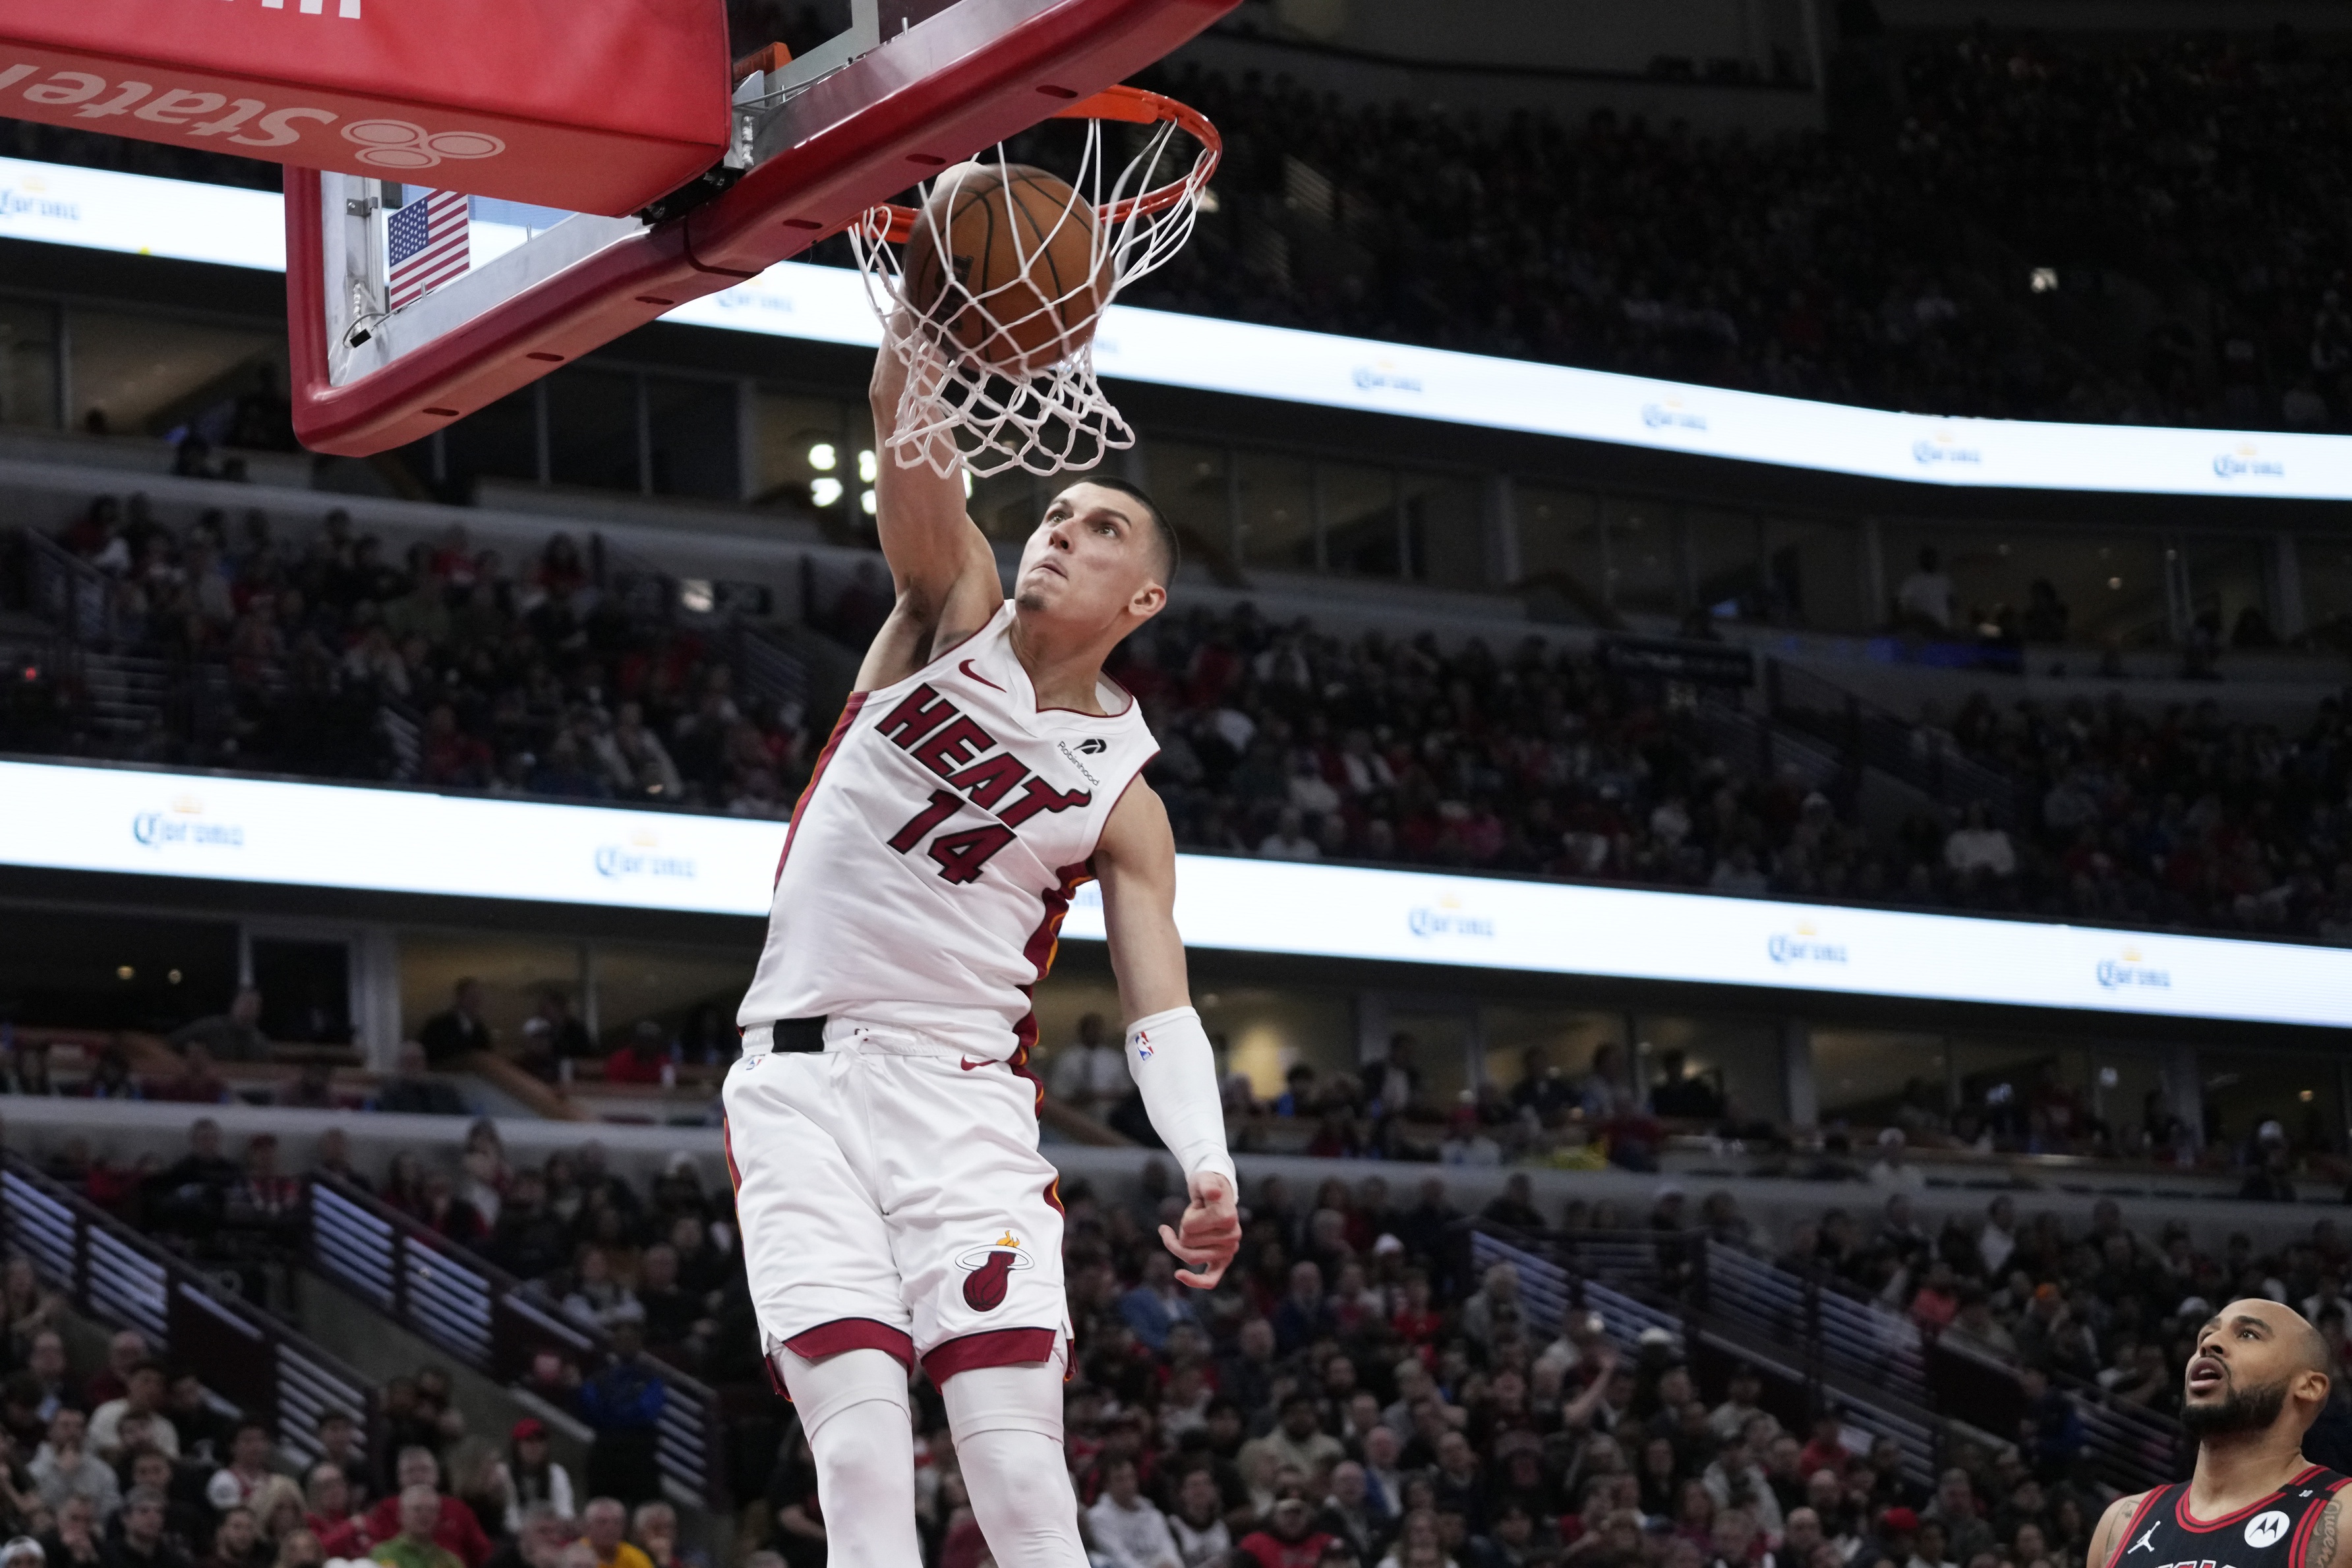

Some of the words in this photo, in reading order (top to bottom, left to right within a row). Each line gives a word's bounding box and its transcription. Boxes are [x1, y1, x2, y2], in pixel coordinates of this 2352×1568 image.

[874, 683, 1092, 829] HEAT
[1057, 741, 1100, 786] Robinhood
[887, 789, 1017, 885] 14
